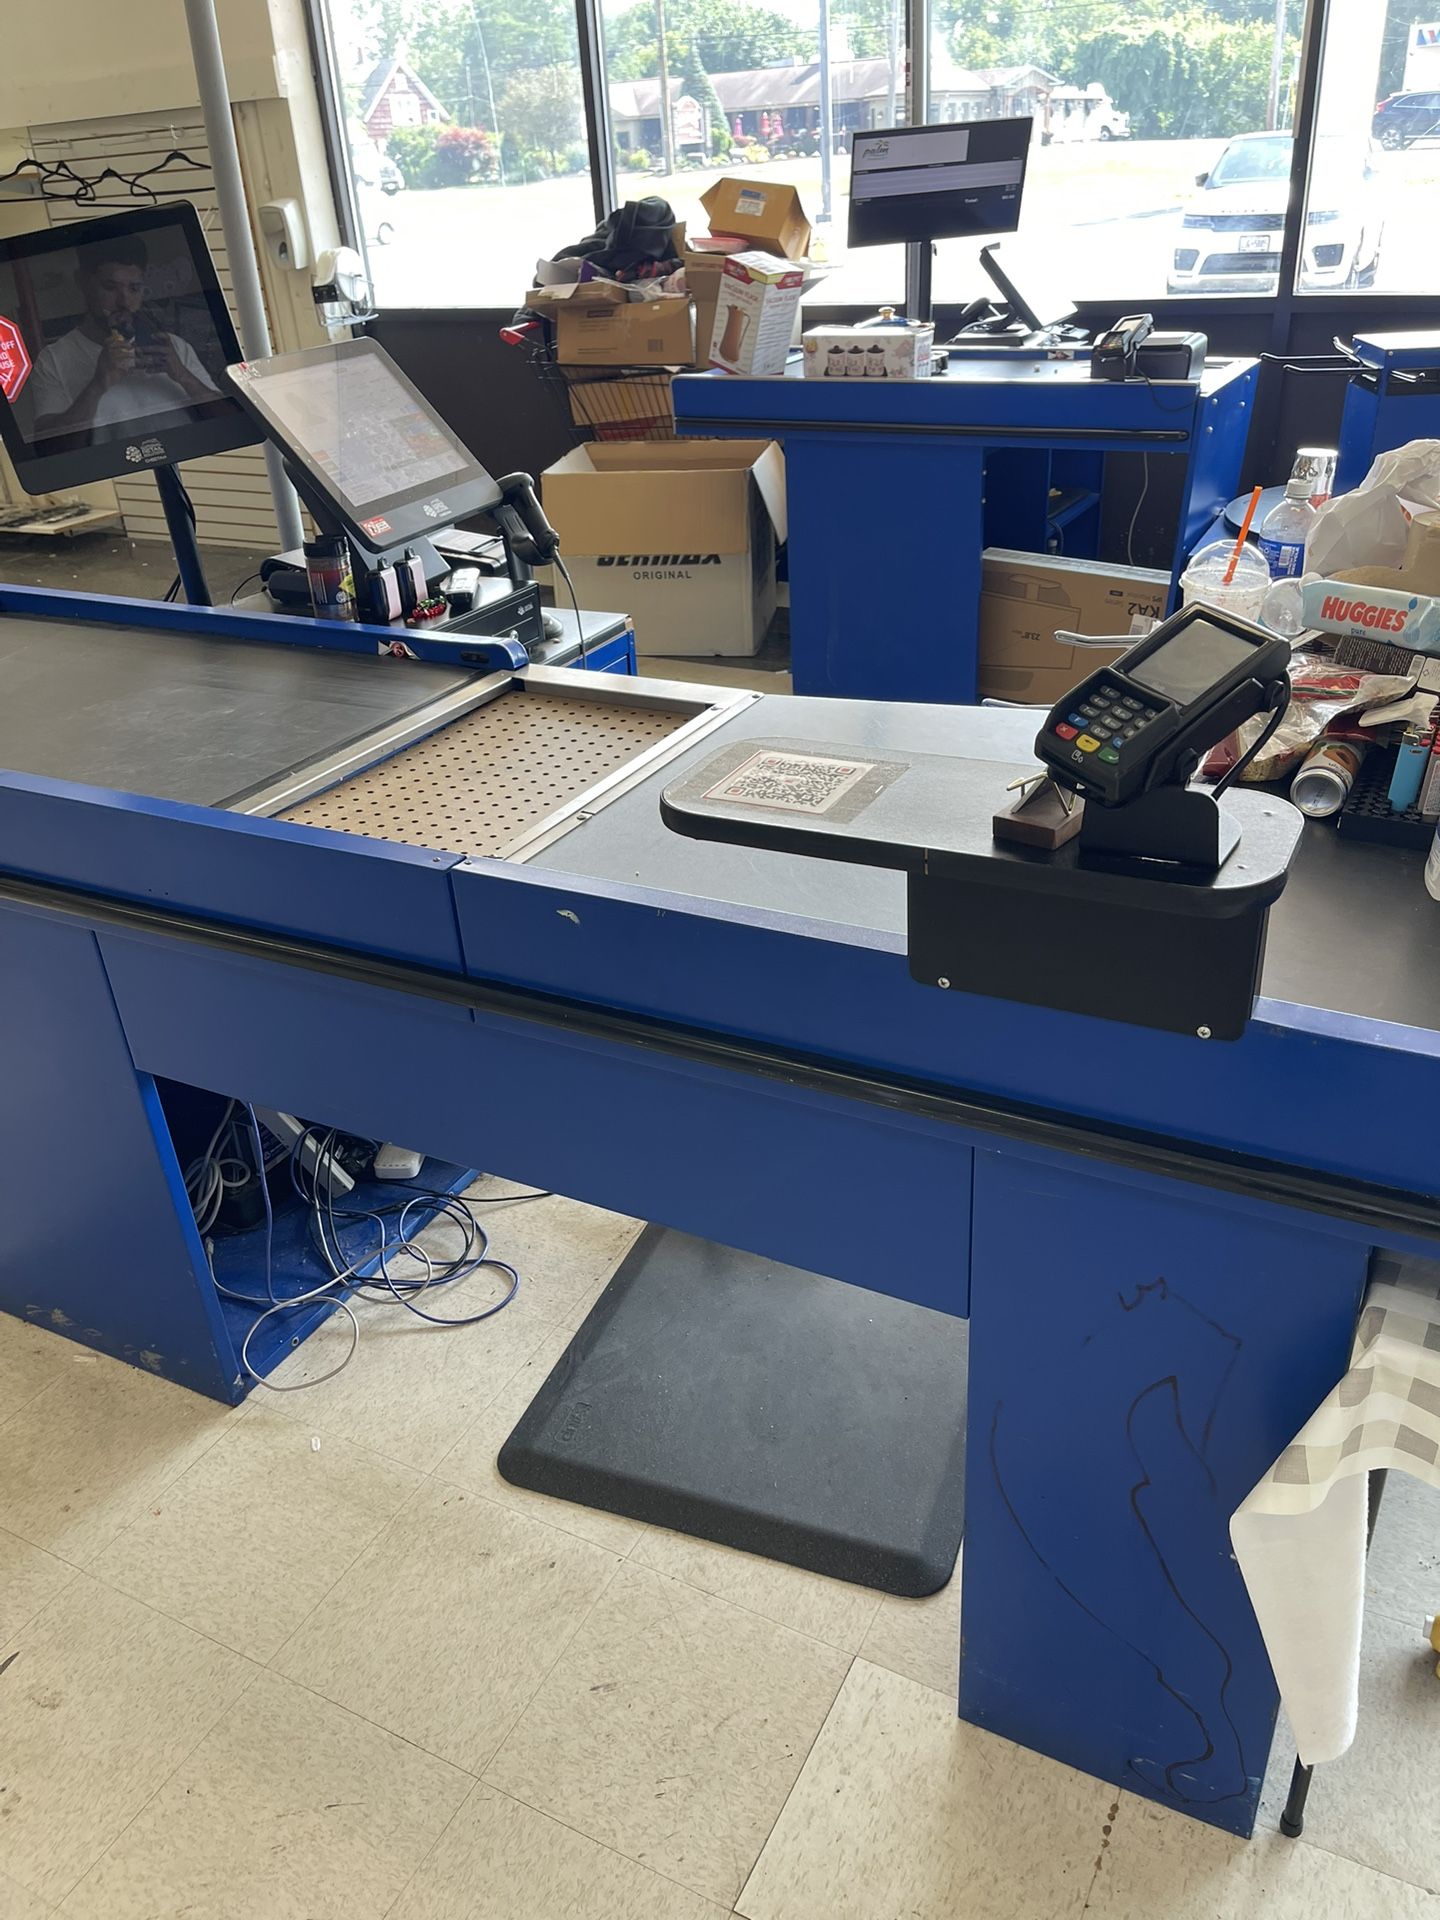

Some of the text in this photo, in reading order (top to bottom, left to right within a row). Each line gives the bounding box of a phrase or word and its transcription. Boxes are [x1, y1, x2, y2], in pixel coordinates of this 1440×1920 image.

[633, 570, 692, 580] ORIGINAL
[1127, 602, 1161, 618] KA2
[1320, 596, 1408, 632] HUGGIES
